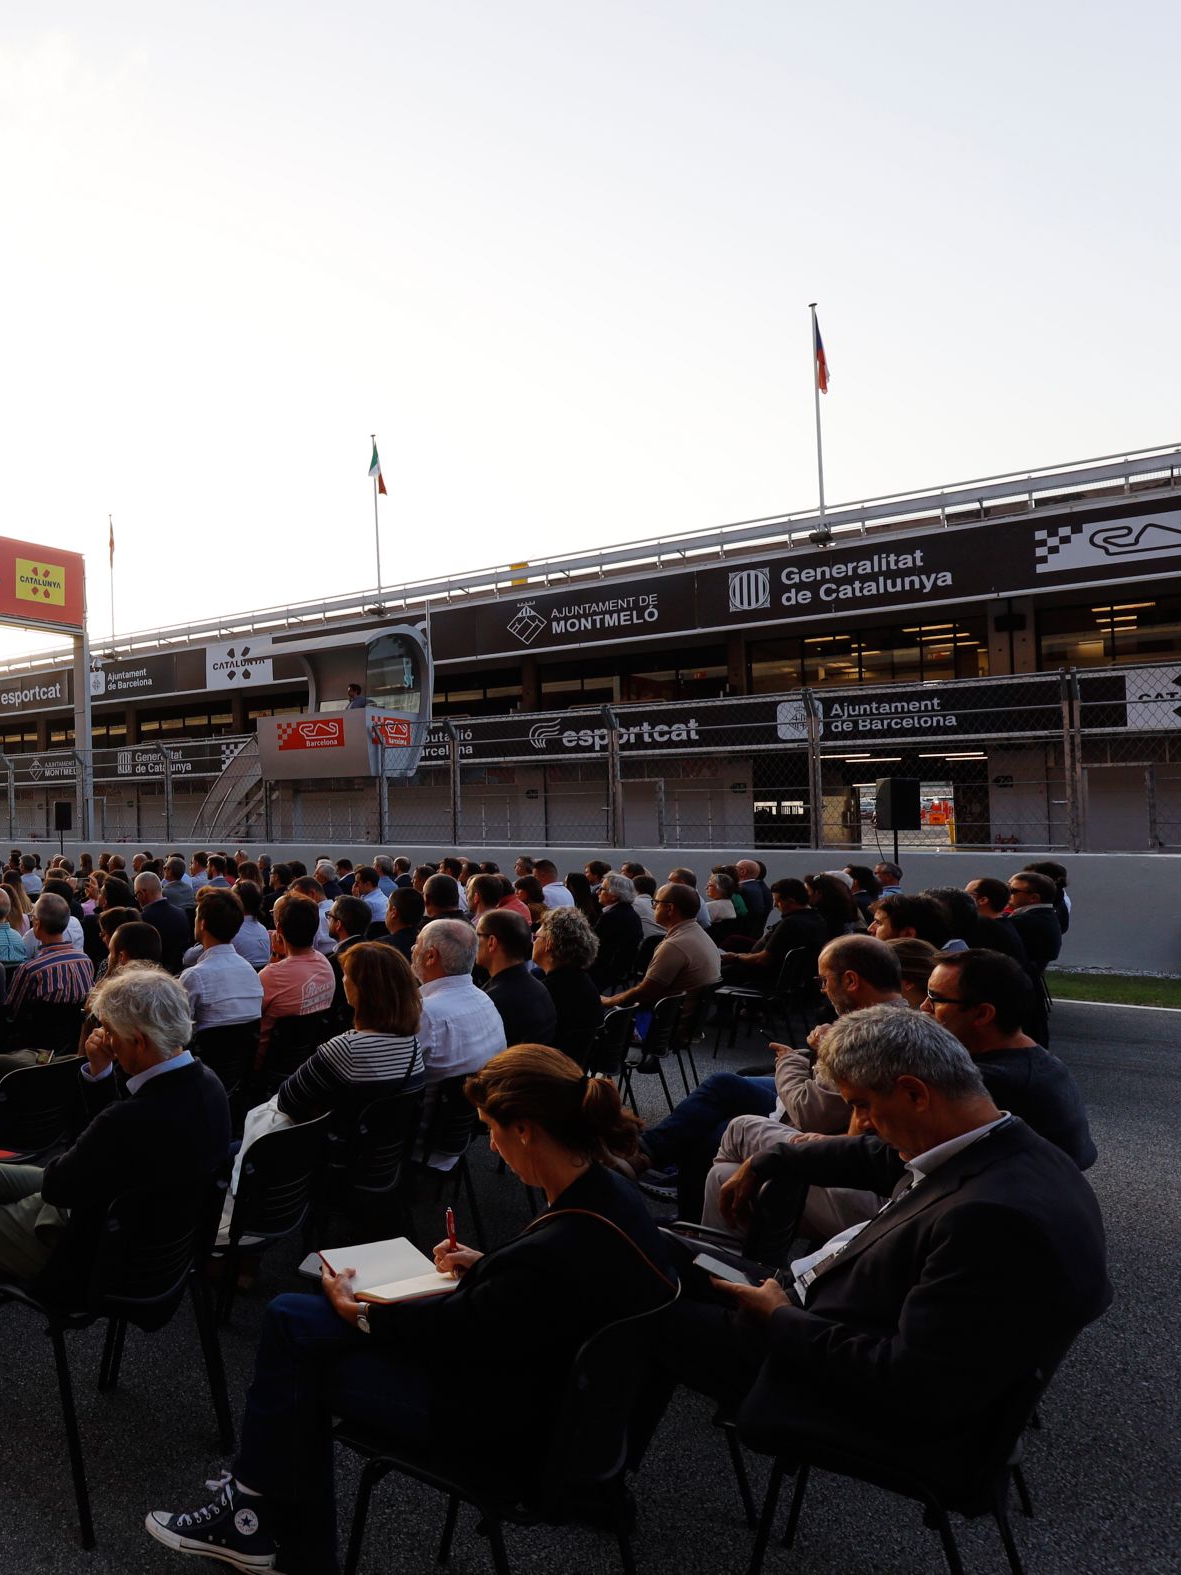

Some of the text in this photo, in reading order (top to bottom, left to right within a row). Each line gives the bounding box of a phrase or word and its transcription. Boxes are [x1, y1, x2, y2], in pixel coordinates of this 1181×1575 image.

[780, 549, 924, 585] Generalitat
[19, 575, 61, 590] CATALUNYA
[781, 571, 953, 606] de Catalunya
[551, 594, 658, 618] AJUNTAMENT DE
[552, 606, 659, 634] MONTMELÓ
[107, 668, 148, 681] Ajuntament
[117, 678, 153, 688] Barcelona
[0, 683, 61, 707] esportcat
[830, 698, 941, 718] Ajuntament
[831, 715, 958, 733] de Barcelona
[306, 738, 338, 747] Barcelona
[135, 764, 146, 773] de
